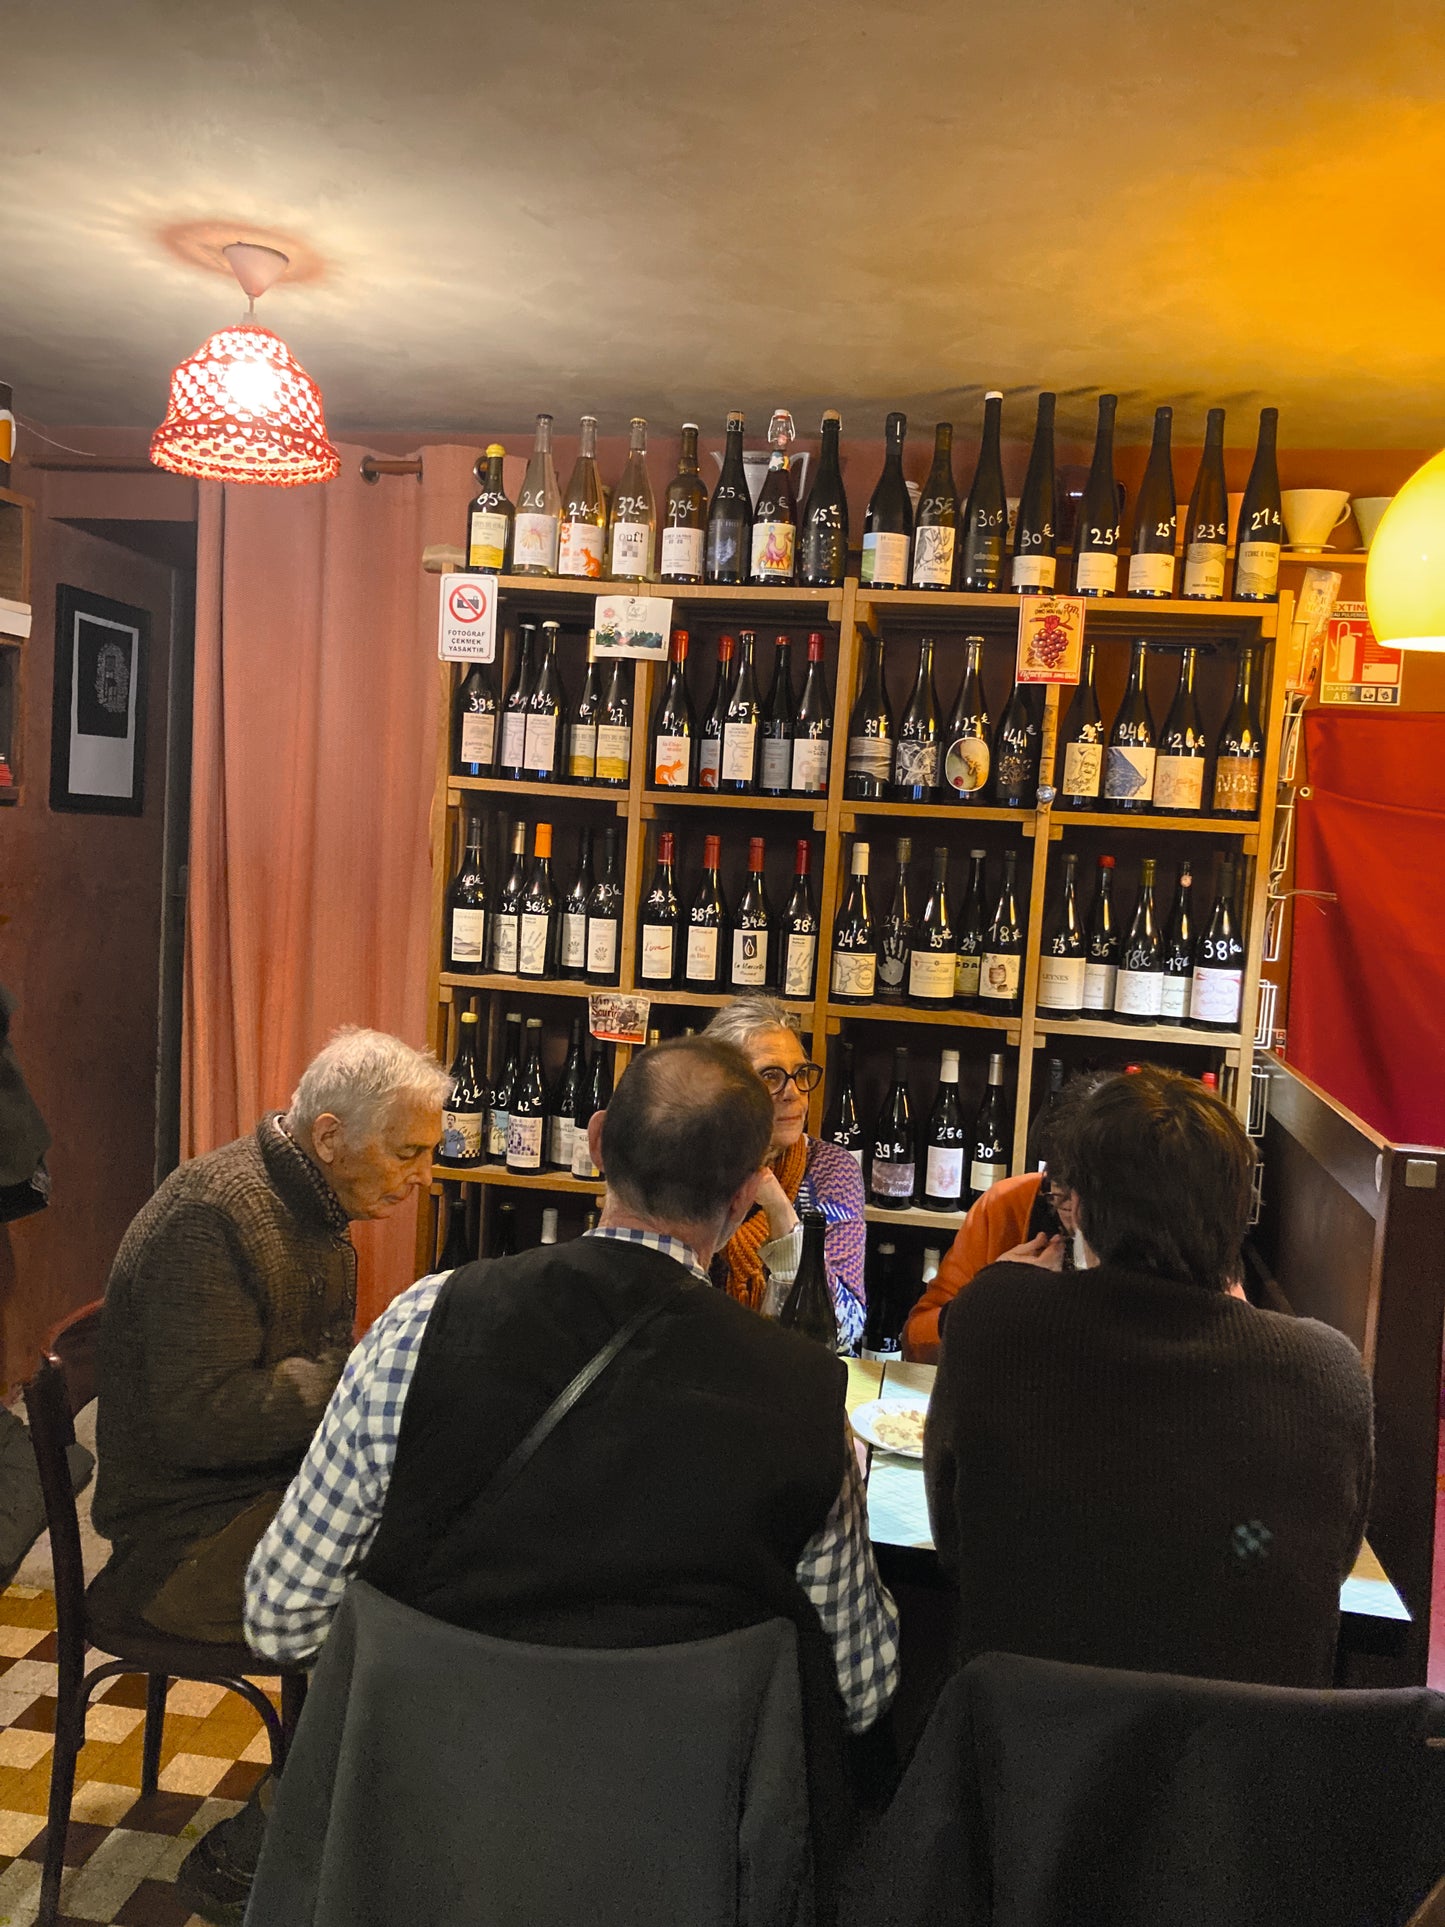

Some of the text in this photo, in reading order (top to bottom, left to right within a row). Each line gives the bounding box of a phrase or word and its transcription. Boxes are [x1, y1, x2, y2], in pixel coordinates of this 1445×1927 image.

[523, 490, 544, 508] 26
[447, 629, 486, 637] FOTOĞRAF
[451, 637, 482, 646] ÇEKMEK
[448, 645, 484, 654] YASAKTIR
